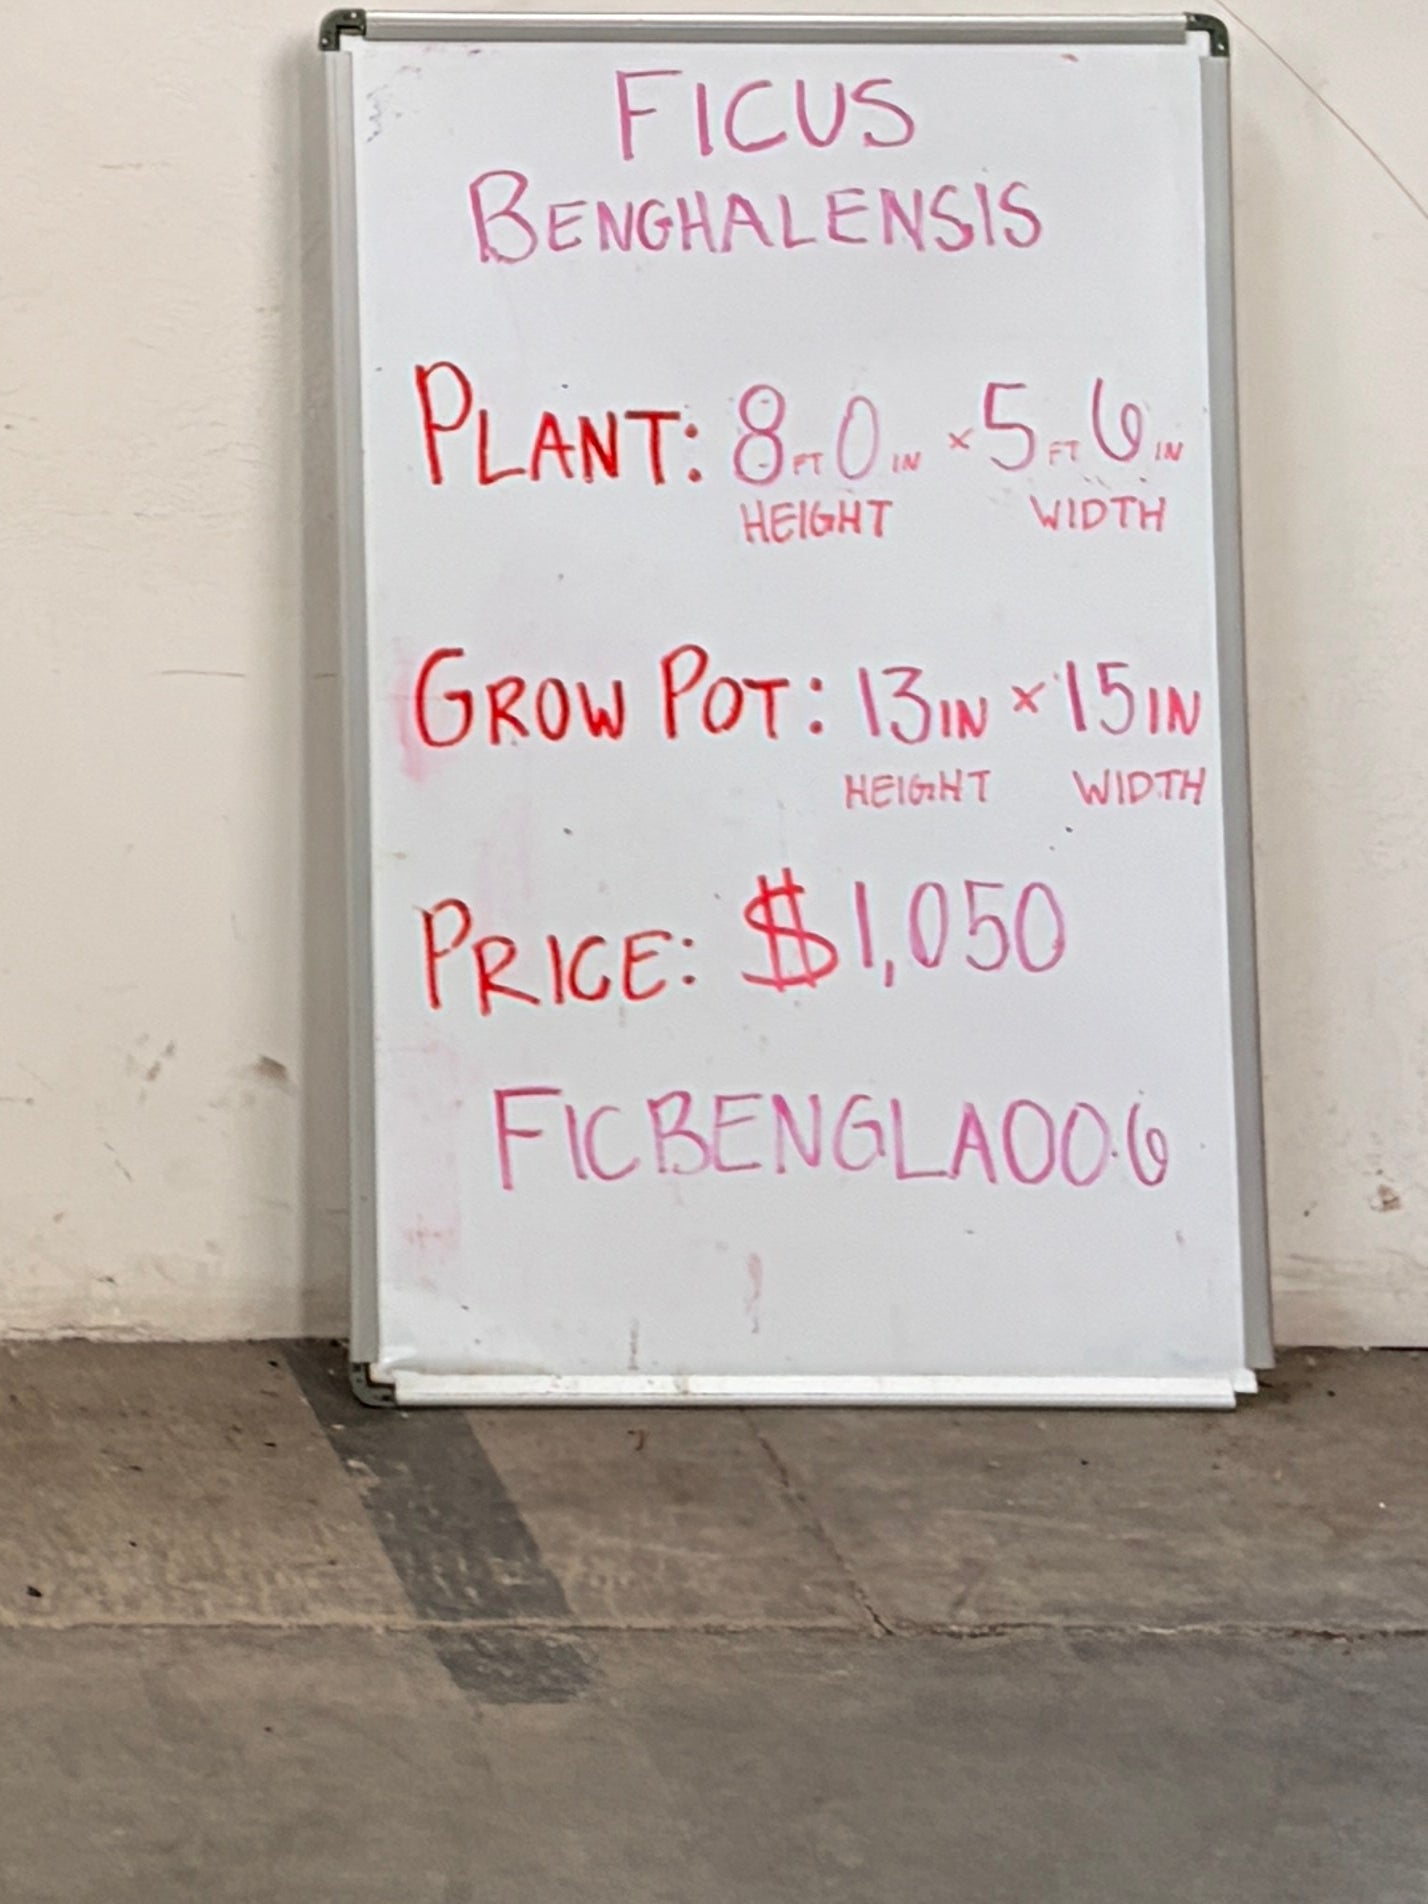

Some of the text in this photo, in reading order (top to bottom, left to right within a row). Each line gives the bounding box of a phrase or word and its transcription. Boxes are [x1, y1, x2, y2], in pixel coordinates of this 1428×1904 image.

[615, 69, 916, 162] FICUS
[468, 170, 1042, 264] BENGHALENSIS
[414, 361, 702, 486] PLANT:
[740, 494, 1167, 545] HEIGHT WIDTH
[414, 647, 627, 745] GROW
[659, 643, 824, 741] POT:
[843, 767, 1206, 810] HEIGHT WIDTH
[421, 867, 1068, 1015] PRICE: $1,050
